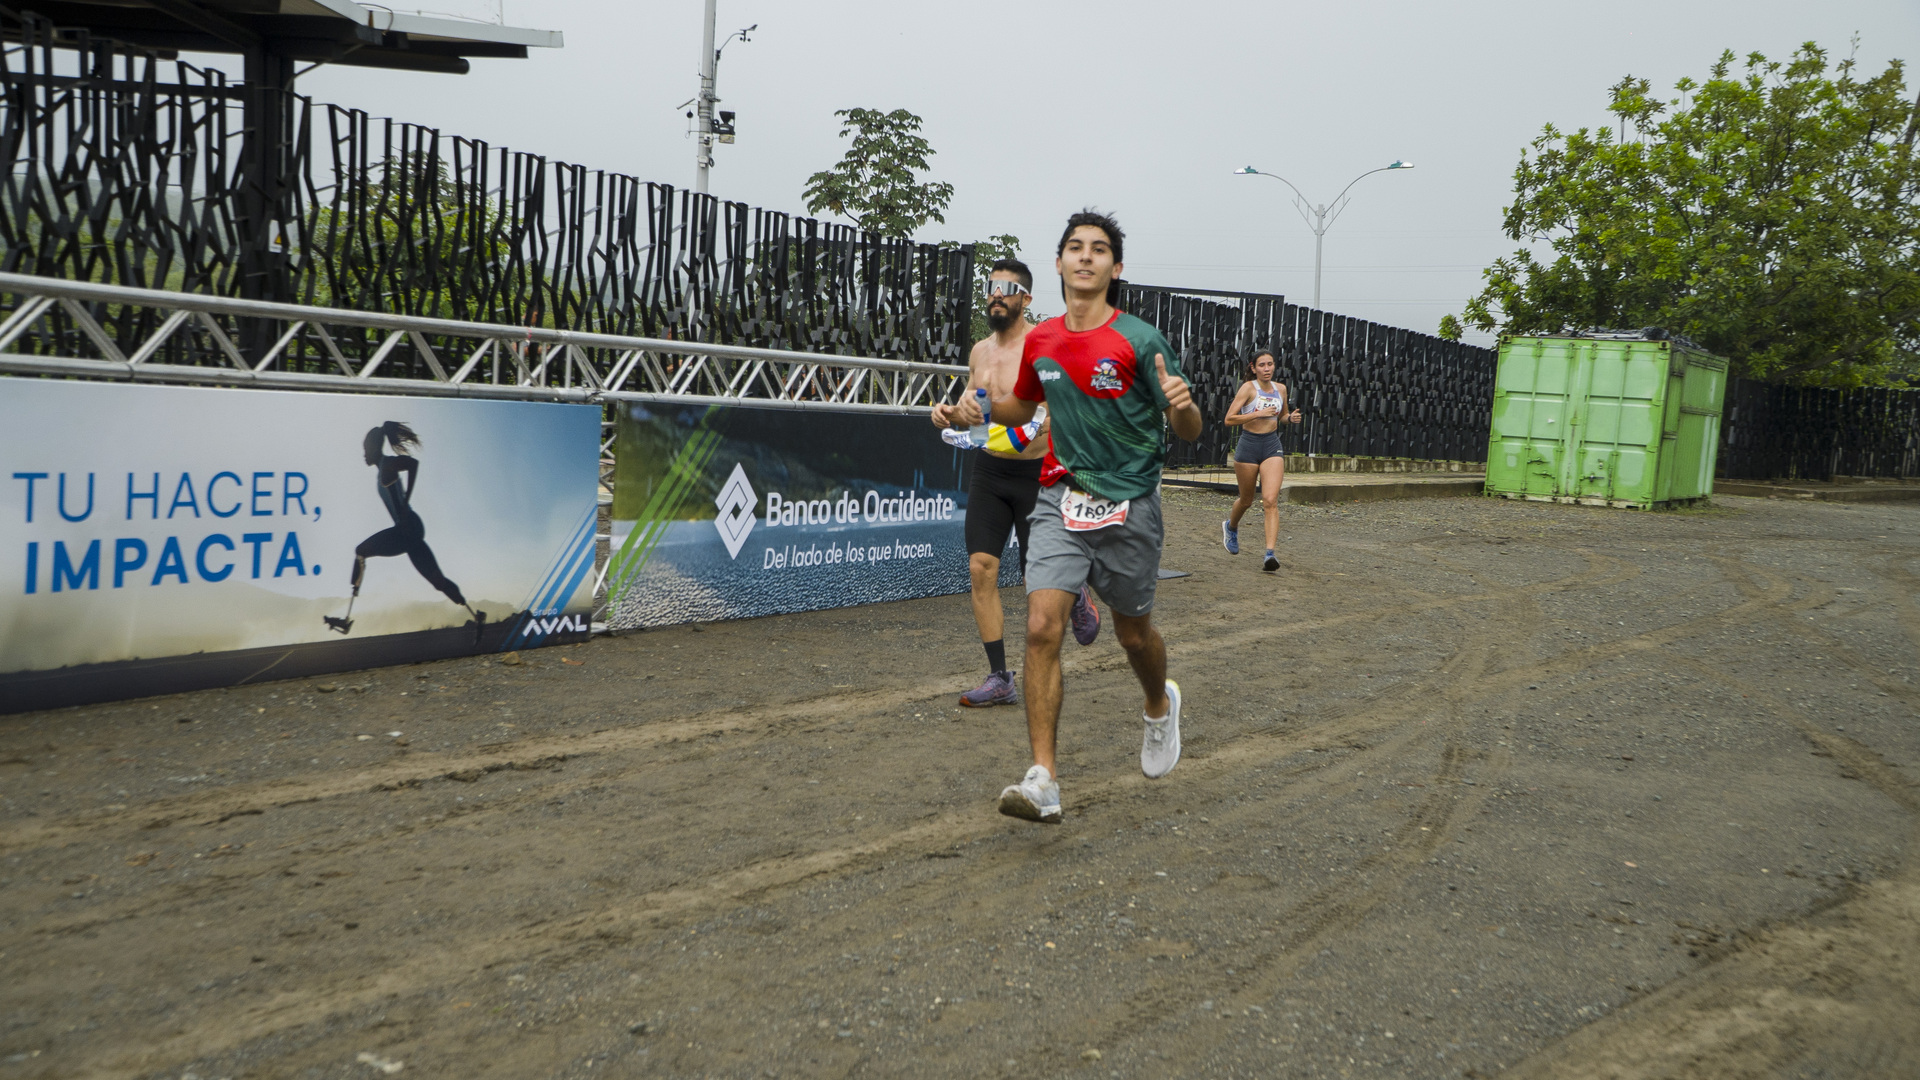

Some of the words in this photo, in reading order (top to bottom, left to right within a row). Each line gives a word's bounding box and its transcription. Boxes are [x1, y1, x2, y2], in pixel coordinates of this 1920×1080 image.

[12, 472, 95, 523] TU
[126, 471, 322, 522] HACER,
[766, 492, 831, 527] Banco
[835, 490, 860, 524] de
[863, 490, 953, 522] Occidente
[24, 531, 322, 595] IMPACTA.
[763, 545, 790, 570] Del
[791, 543, 823, 568] lado
[825, 541, 843, 564] de
[845, 540, 865, 563] los
[867, 546, 892, 566] que
[895, 538, 934, 560] hacen.
[522, 614, 587, 636] AVAL
